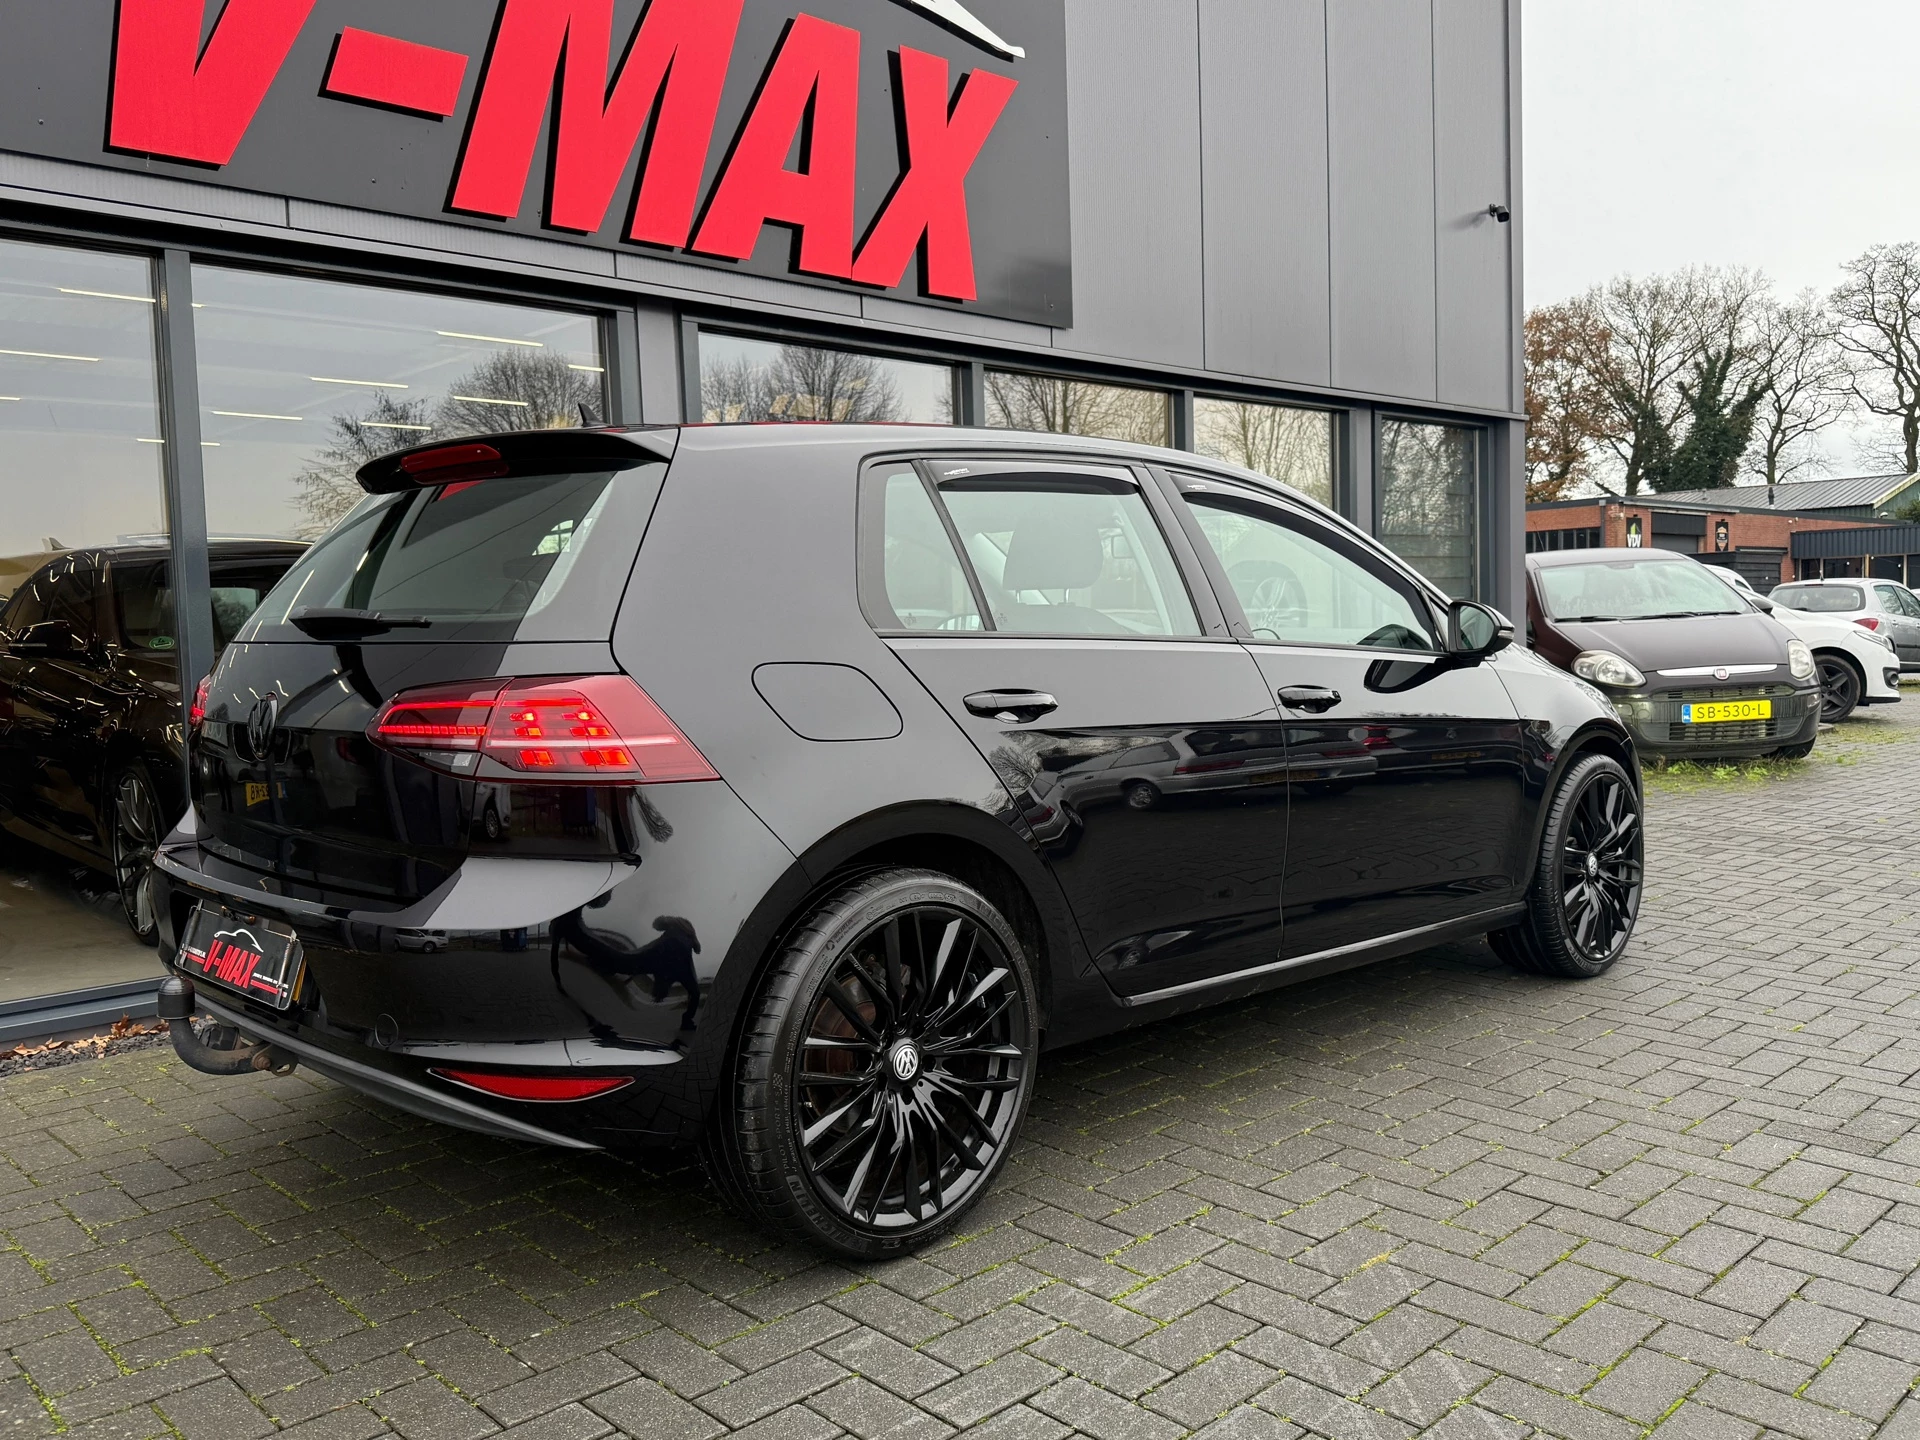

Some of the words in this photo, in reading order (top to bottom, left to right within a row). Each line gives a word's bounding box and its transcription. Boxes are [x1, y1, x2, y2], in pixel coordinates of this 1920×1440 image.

[1696, 703, 1766, 719] SB-530-L
[202, 938, 262, 989] V-MAX
[774, 1107, 784, 1140] SPORT
[778, 1143, 790, 1170] PILOT
